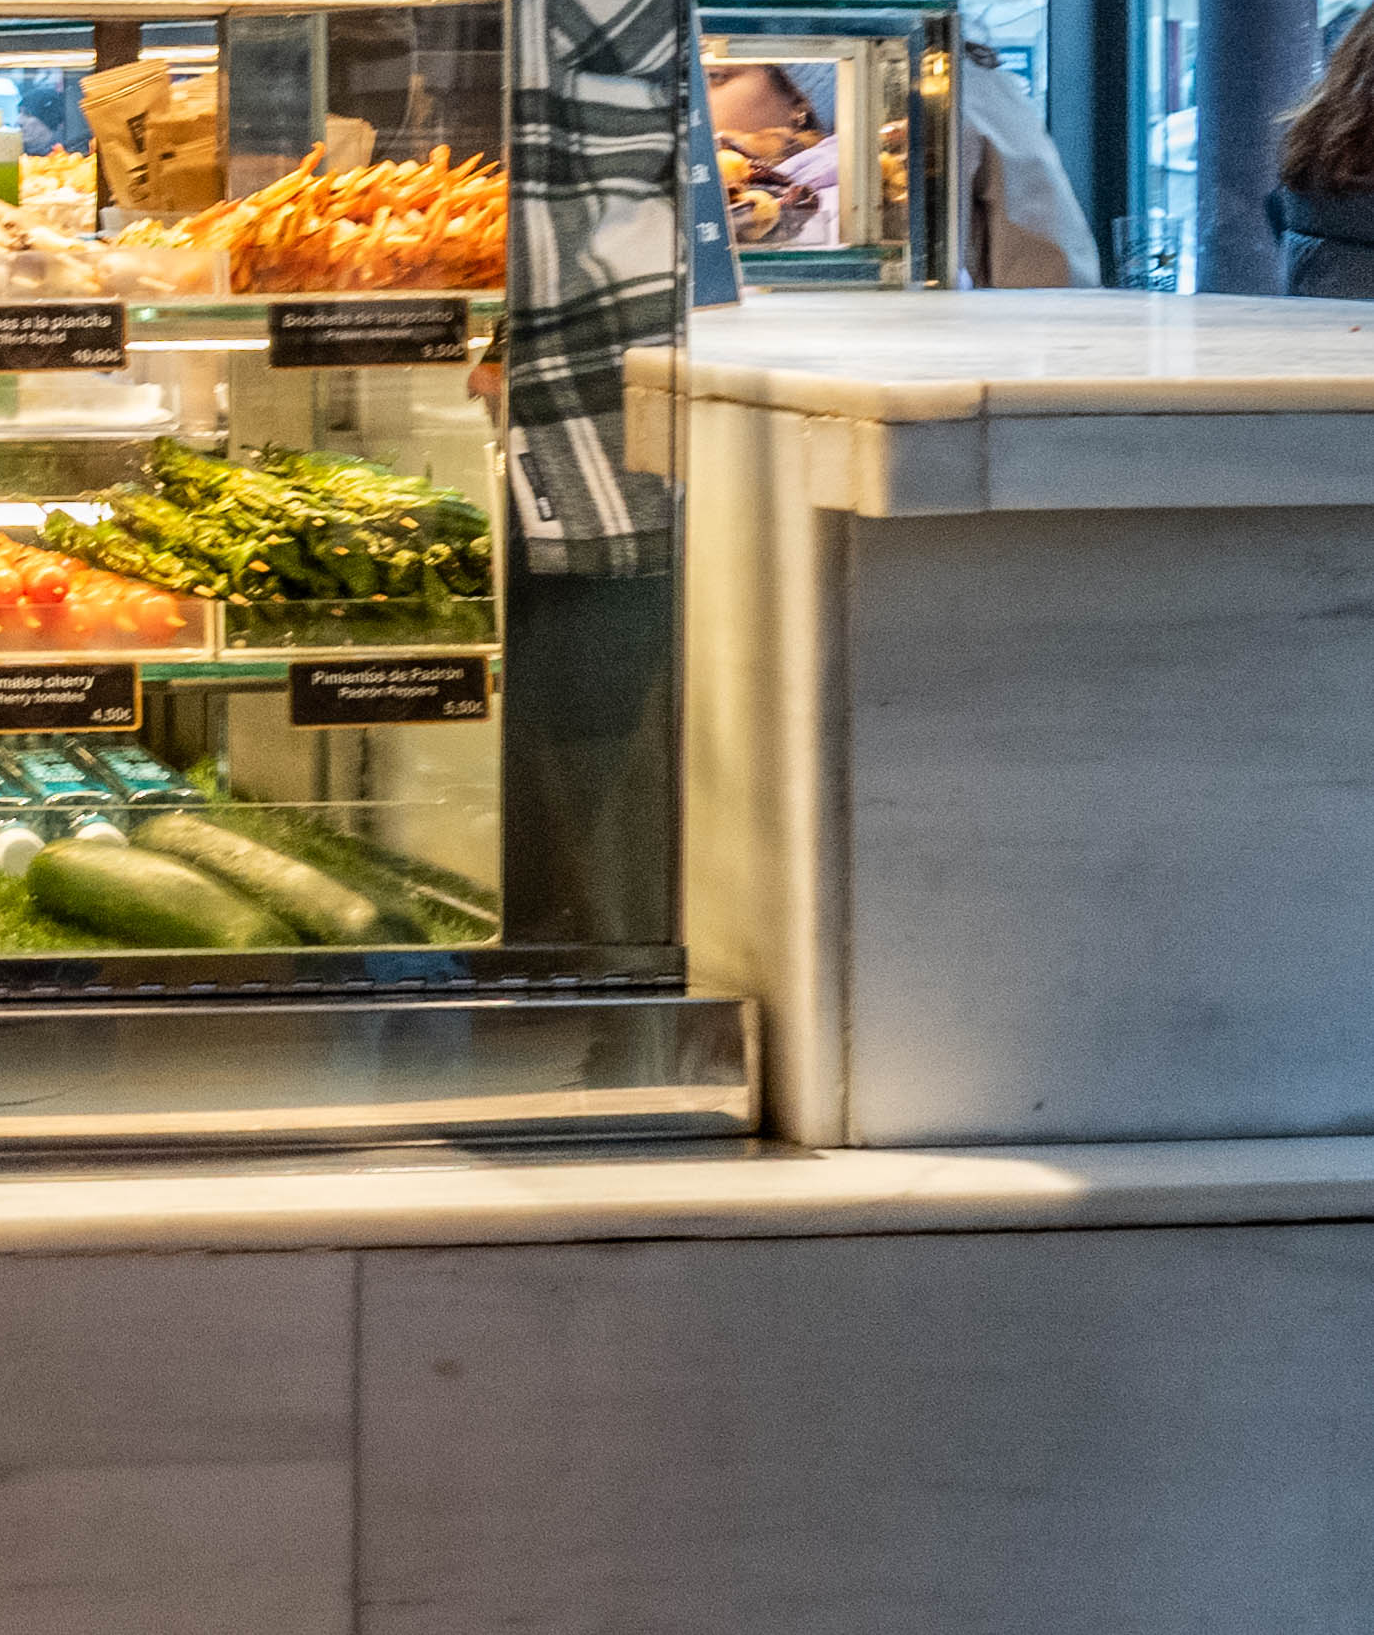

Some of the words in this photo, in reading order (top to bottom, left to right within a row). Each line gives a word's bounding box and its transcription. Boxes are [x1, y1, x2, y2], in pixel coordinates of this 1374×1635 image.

[20, 317, 32, 331] a
[34, 315, 50, 330] la
[51, 314, 111, 331] plancha
[44, 674, 95, 691] cherry
[387, 669, 408, 682] de
